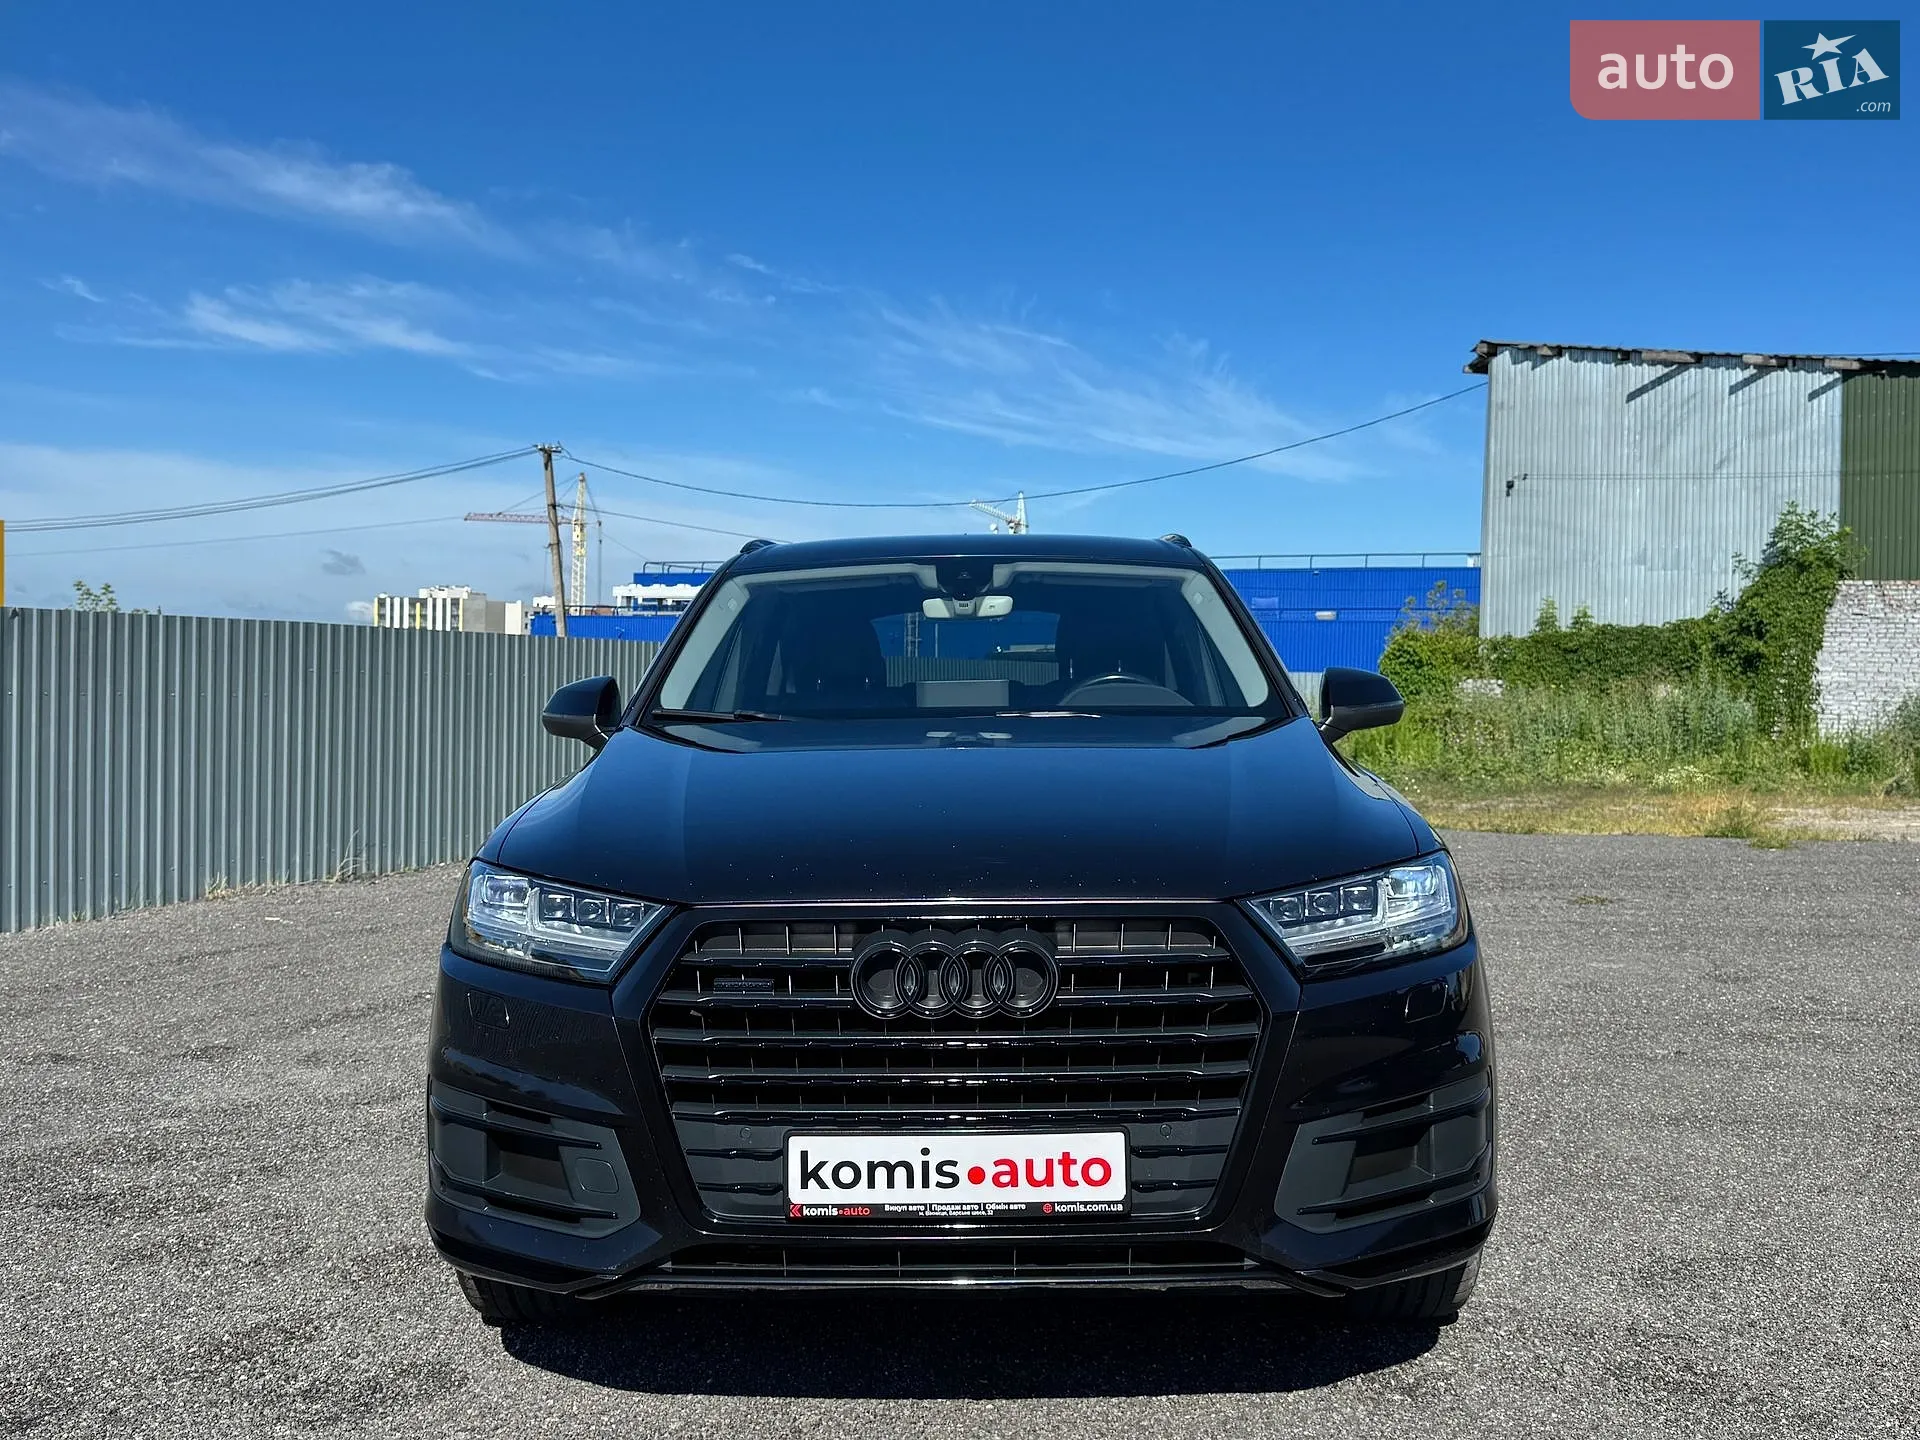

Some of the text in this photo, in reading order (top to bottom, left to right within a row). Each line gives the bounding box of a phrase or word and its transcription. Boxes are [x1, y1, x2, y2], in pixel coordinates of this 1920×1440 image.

[884, 1204, 908, 1213] Викуп
[931, 1204, 961, 1212] Продаж
[985, 1202, 1008, 1210] Обмін
[1054, 1202, 1124, 1213] komis.com.ua
